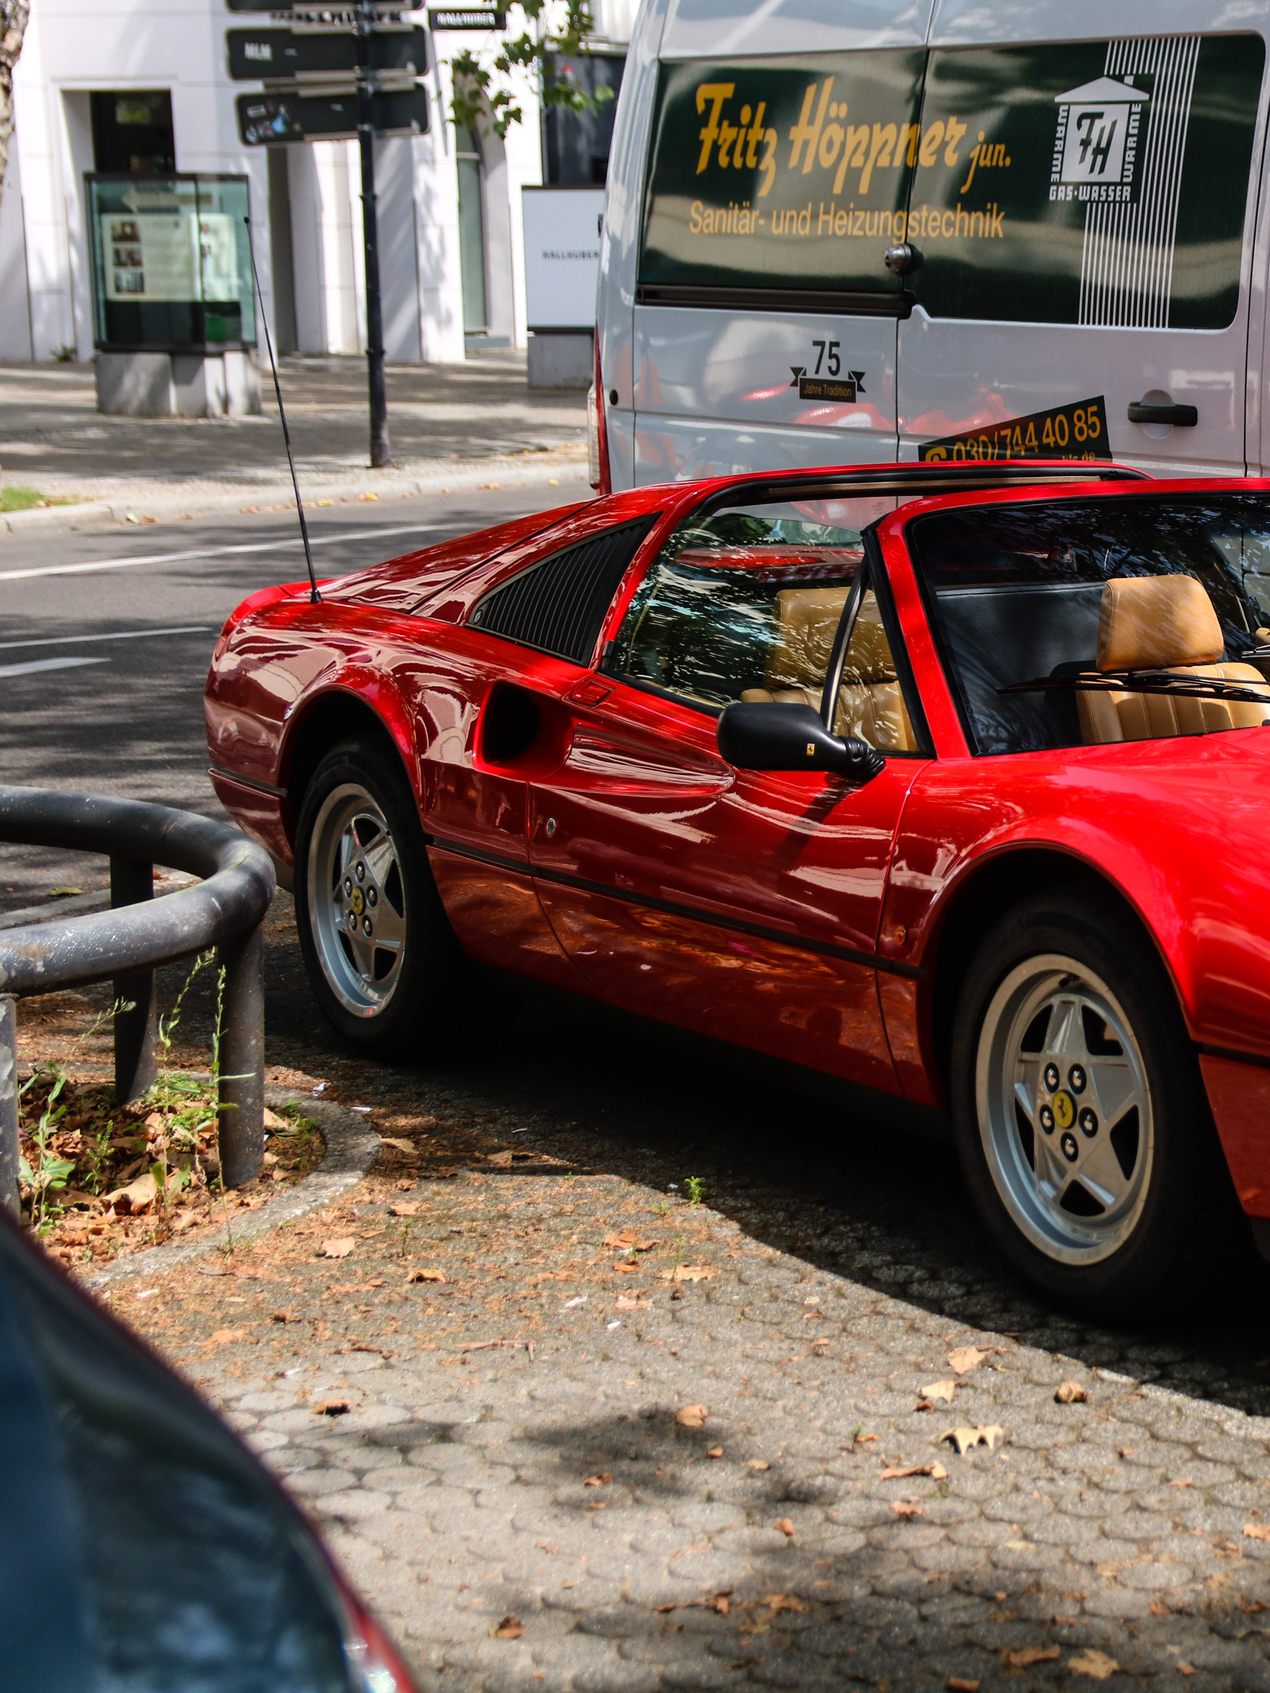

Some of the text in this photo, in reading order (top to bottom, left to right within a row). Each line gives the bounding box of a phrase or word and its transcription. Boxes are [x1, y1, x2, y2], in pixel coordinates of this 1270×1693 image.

[696, 75, 1012, 197] Fritz Höppner jun.
[689, 200, 1006, 244] Sanitär- und Heizungstechnik
[812, 340, 841, 377] 75
[803, 383, 852, 397] Jahre Tradition
[1042, 413, 1069, 448] 40
[1073, 405, 1101, 442] 85
